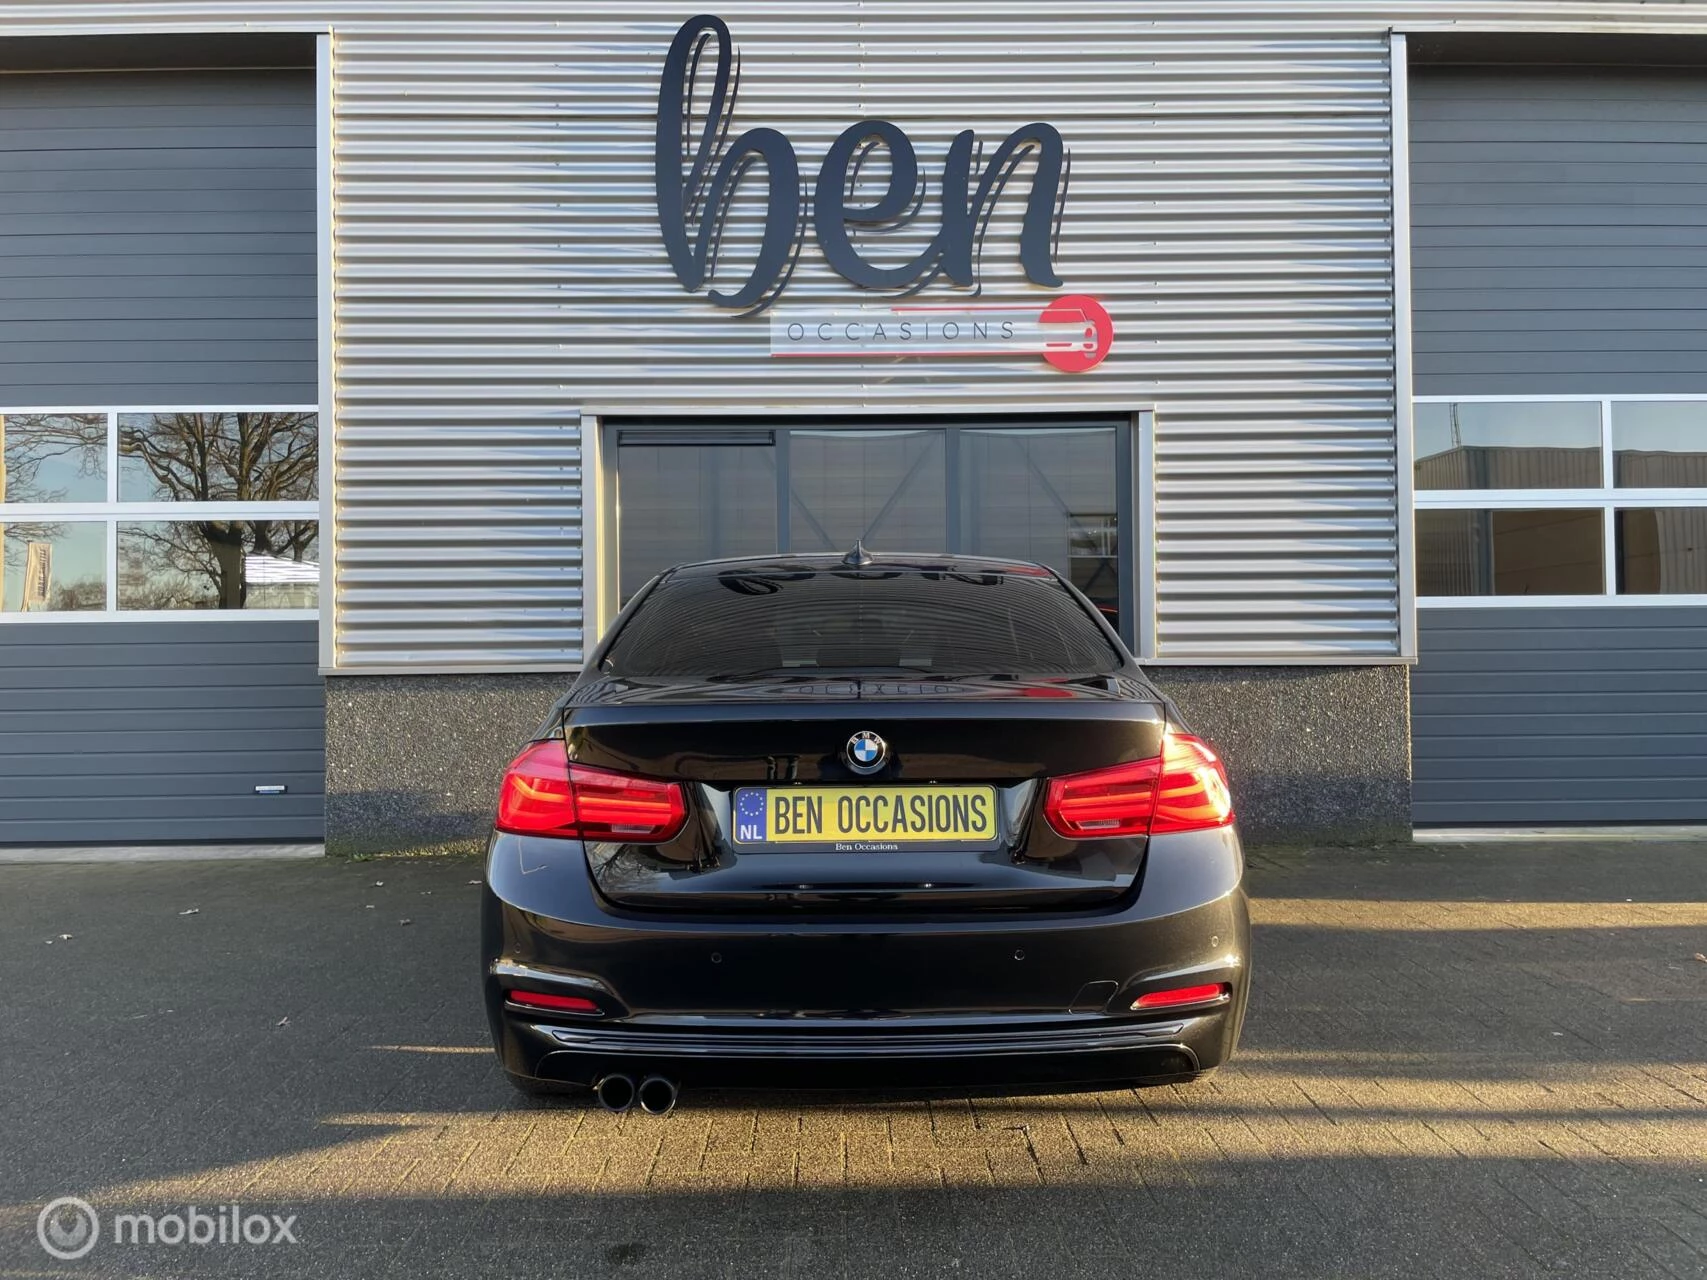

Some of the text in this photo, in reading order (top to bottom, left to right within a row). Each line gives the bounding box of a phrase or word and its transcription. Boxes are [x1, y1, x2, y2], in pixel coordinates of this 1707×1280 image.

[655, 14, 1064, 308] ben
[786, 320, 1015, 342] OCCASIONS
[850, 732, 881, 744] BMW
[774, 794, 987, 835] BEN OCCASIONS
[740, 824, 762, 840] NL
[835, 843, 898, 851] Ben Occasions
